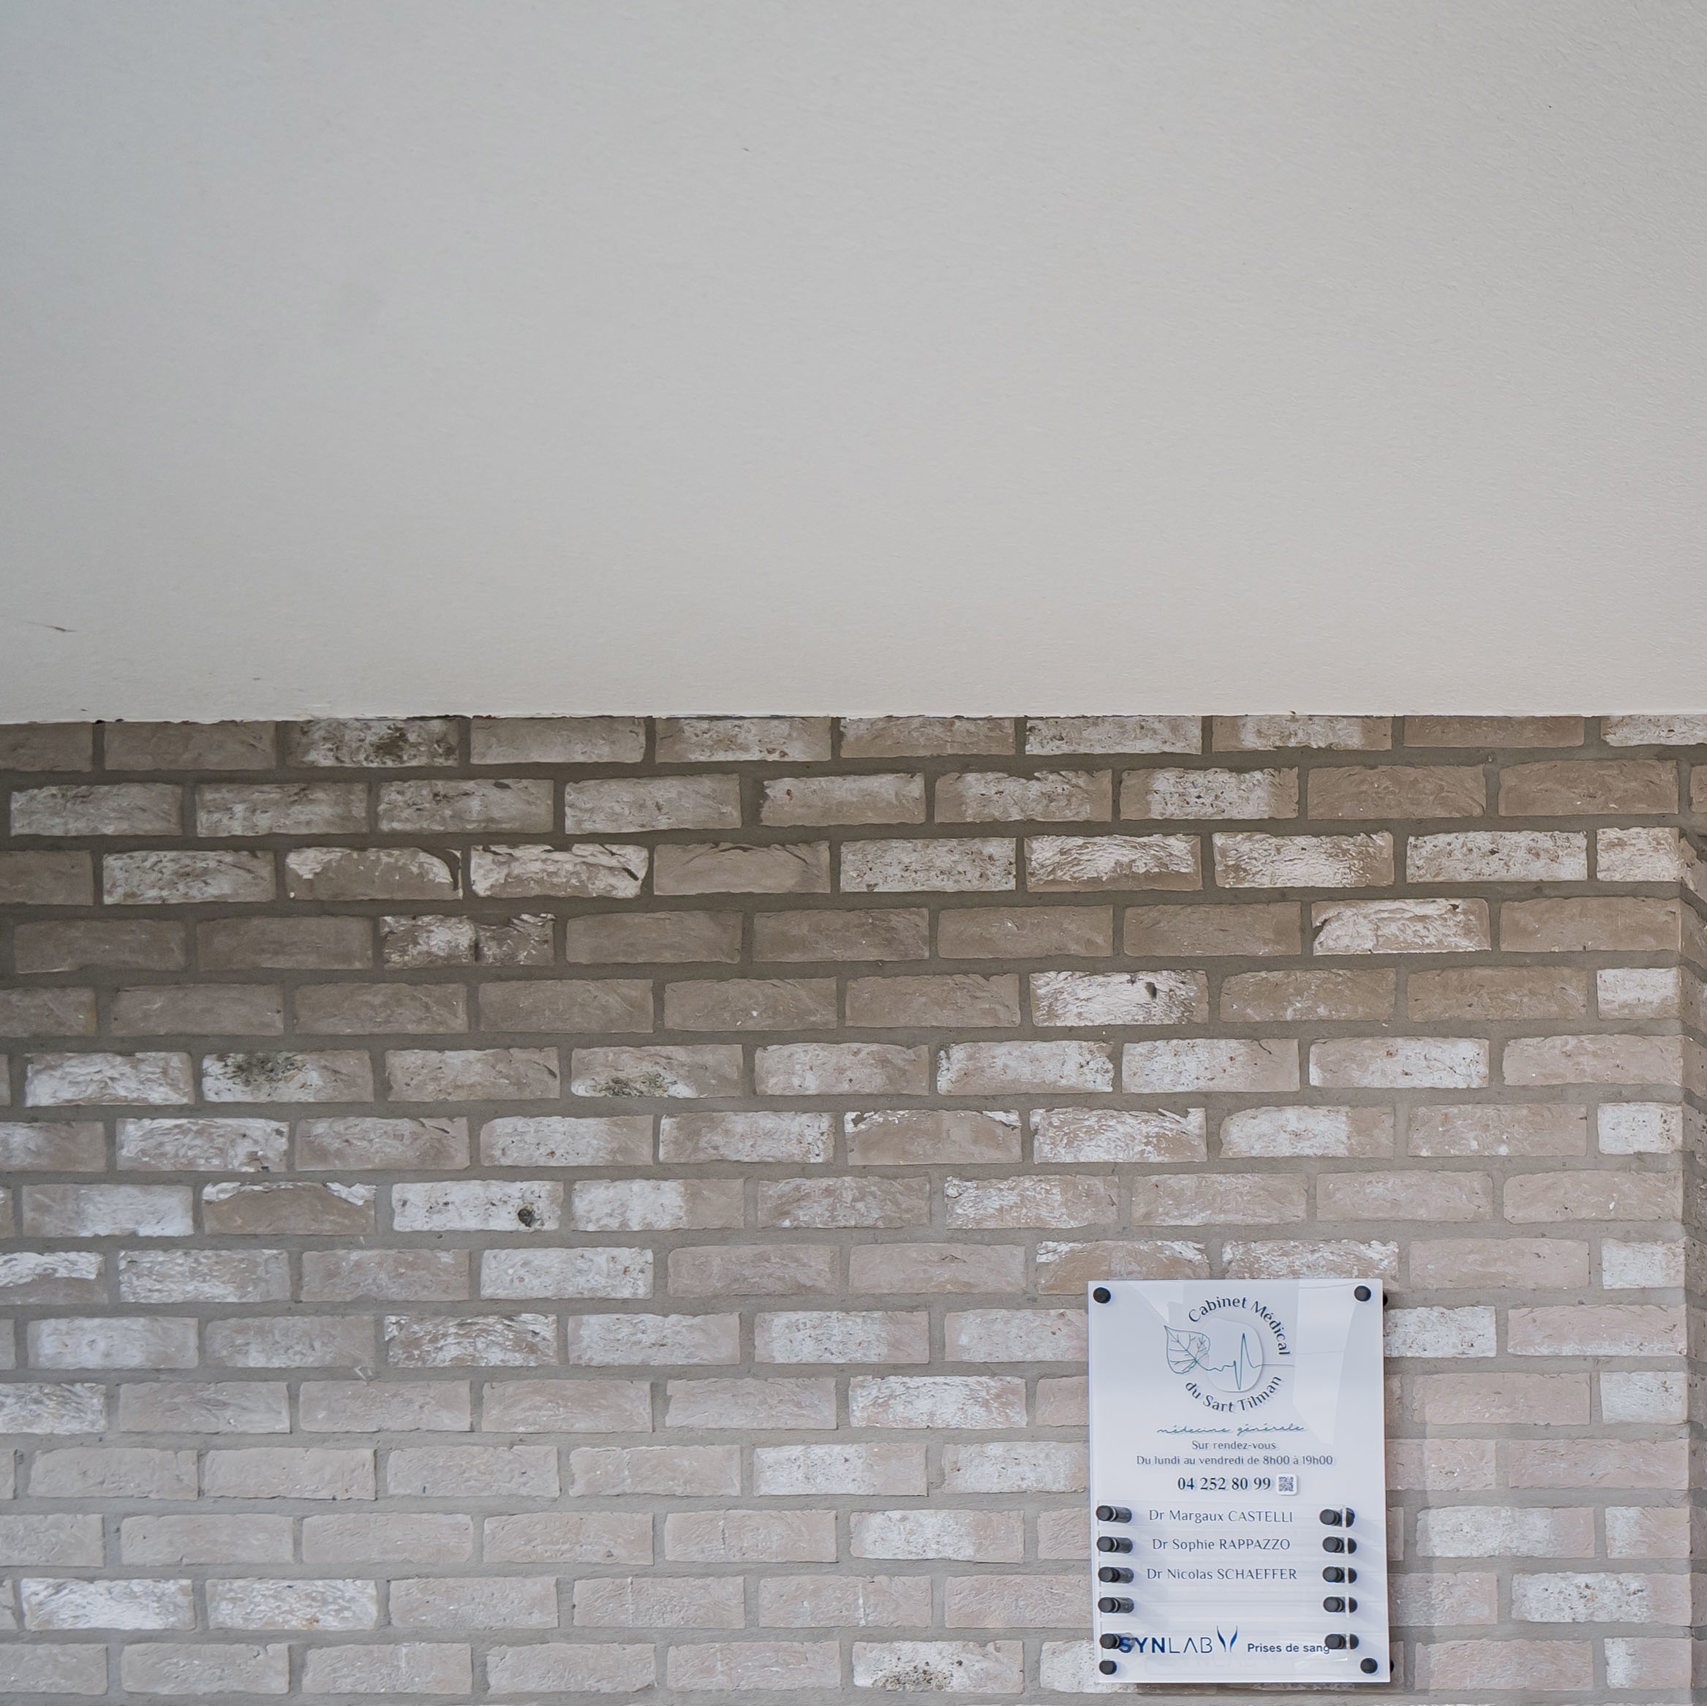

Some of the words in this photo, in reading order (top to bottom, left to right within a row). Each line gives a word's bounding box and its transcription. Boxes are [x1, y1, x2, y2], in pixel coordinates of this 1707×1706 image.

[1188, 1297, 1247, 1322] Cabinet
[1250, 1300, 1290, 1356] Médical
[1184, 1380, 1203, 1399] du
[1203, 1393, 1235, 1413] Sart
[1238, 1373, 1282, 1411] Tilman
[1192, 1440, 1208, 1451] Sur
[1213, 1440, 1276, 1451] rendez-vous
[1137, 1455, 1151, 1465] Du
[1155, 1455, 1180, 1465] lundi
[1199, 1455, 1245, 1465] vendredi
[1248, 1455, 1260, 1465] de
[1263, 1455, 1290, 1465] 8h00
[1293, 1455, 1299, 1465] à
[1303, 1455, 1333, 1465] 19h00
[1178, 1477, 1195, 1490] 04
[1200, 1477, 1226, 1490] 252
[1232, 1477, 1248, 1490] 80
[1254, 1477, 1271, 1490] 99
[1149, 1510, 1165, 1521] Dr
[1169, 1510, 1224, 1524] Margaux
[1228, 1509, 1293, 1522] CASTELLI
[1152, 1539, 1169, 1550] Dr
[1172, 1538, 1215, 1553] Sophie
[1219, 1539, 1290, 1550] RAPPAZZO
[1147, 1568, 1164, 1580] Dr
[1167, 1568, 1213, 1580] Nicolas
[1217, 1568, 1297, 1580] SCHAEFFER
[1119, 1636, 1213, 1654] SYNLAB
[1247, 1643, 1282, 1653] Prises
[1285, 1643, 1300, 1653] de
[1303, 1644, 1330, 1655] sang
